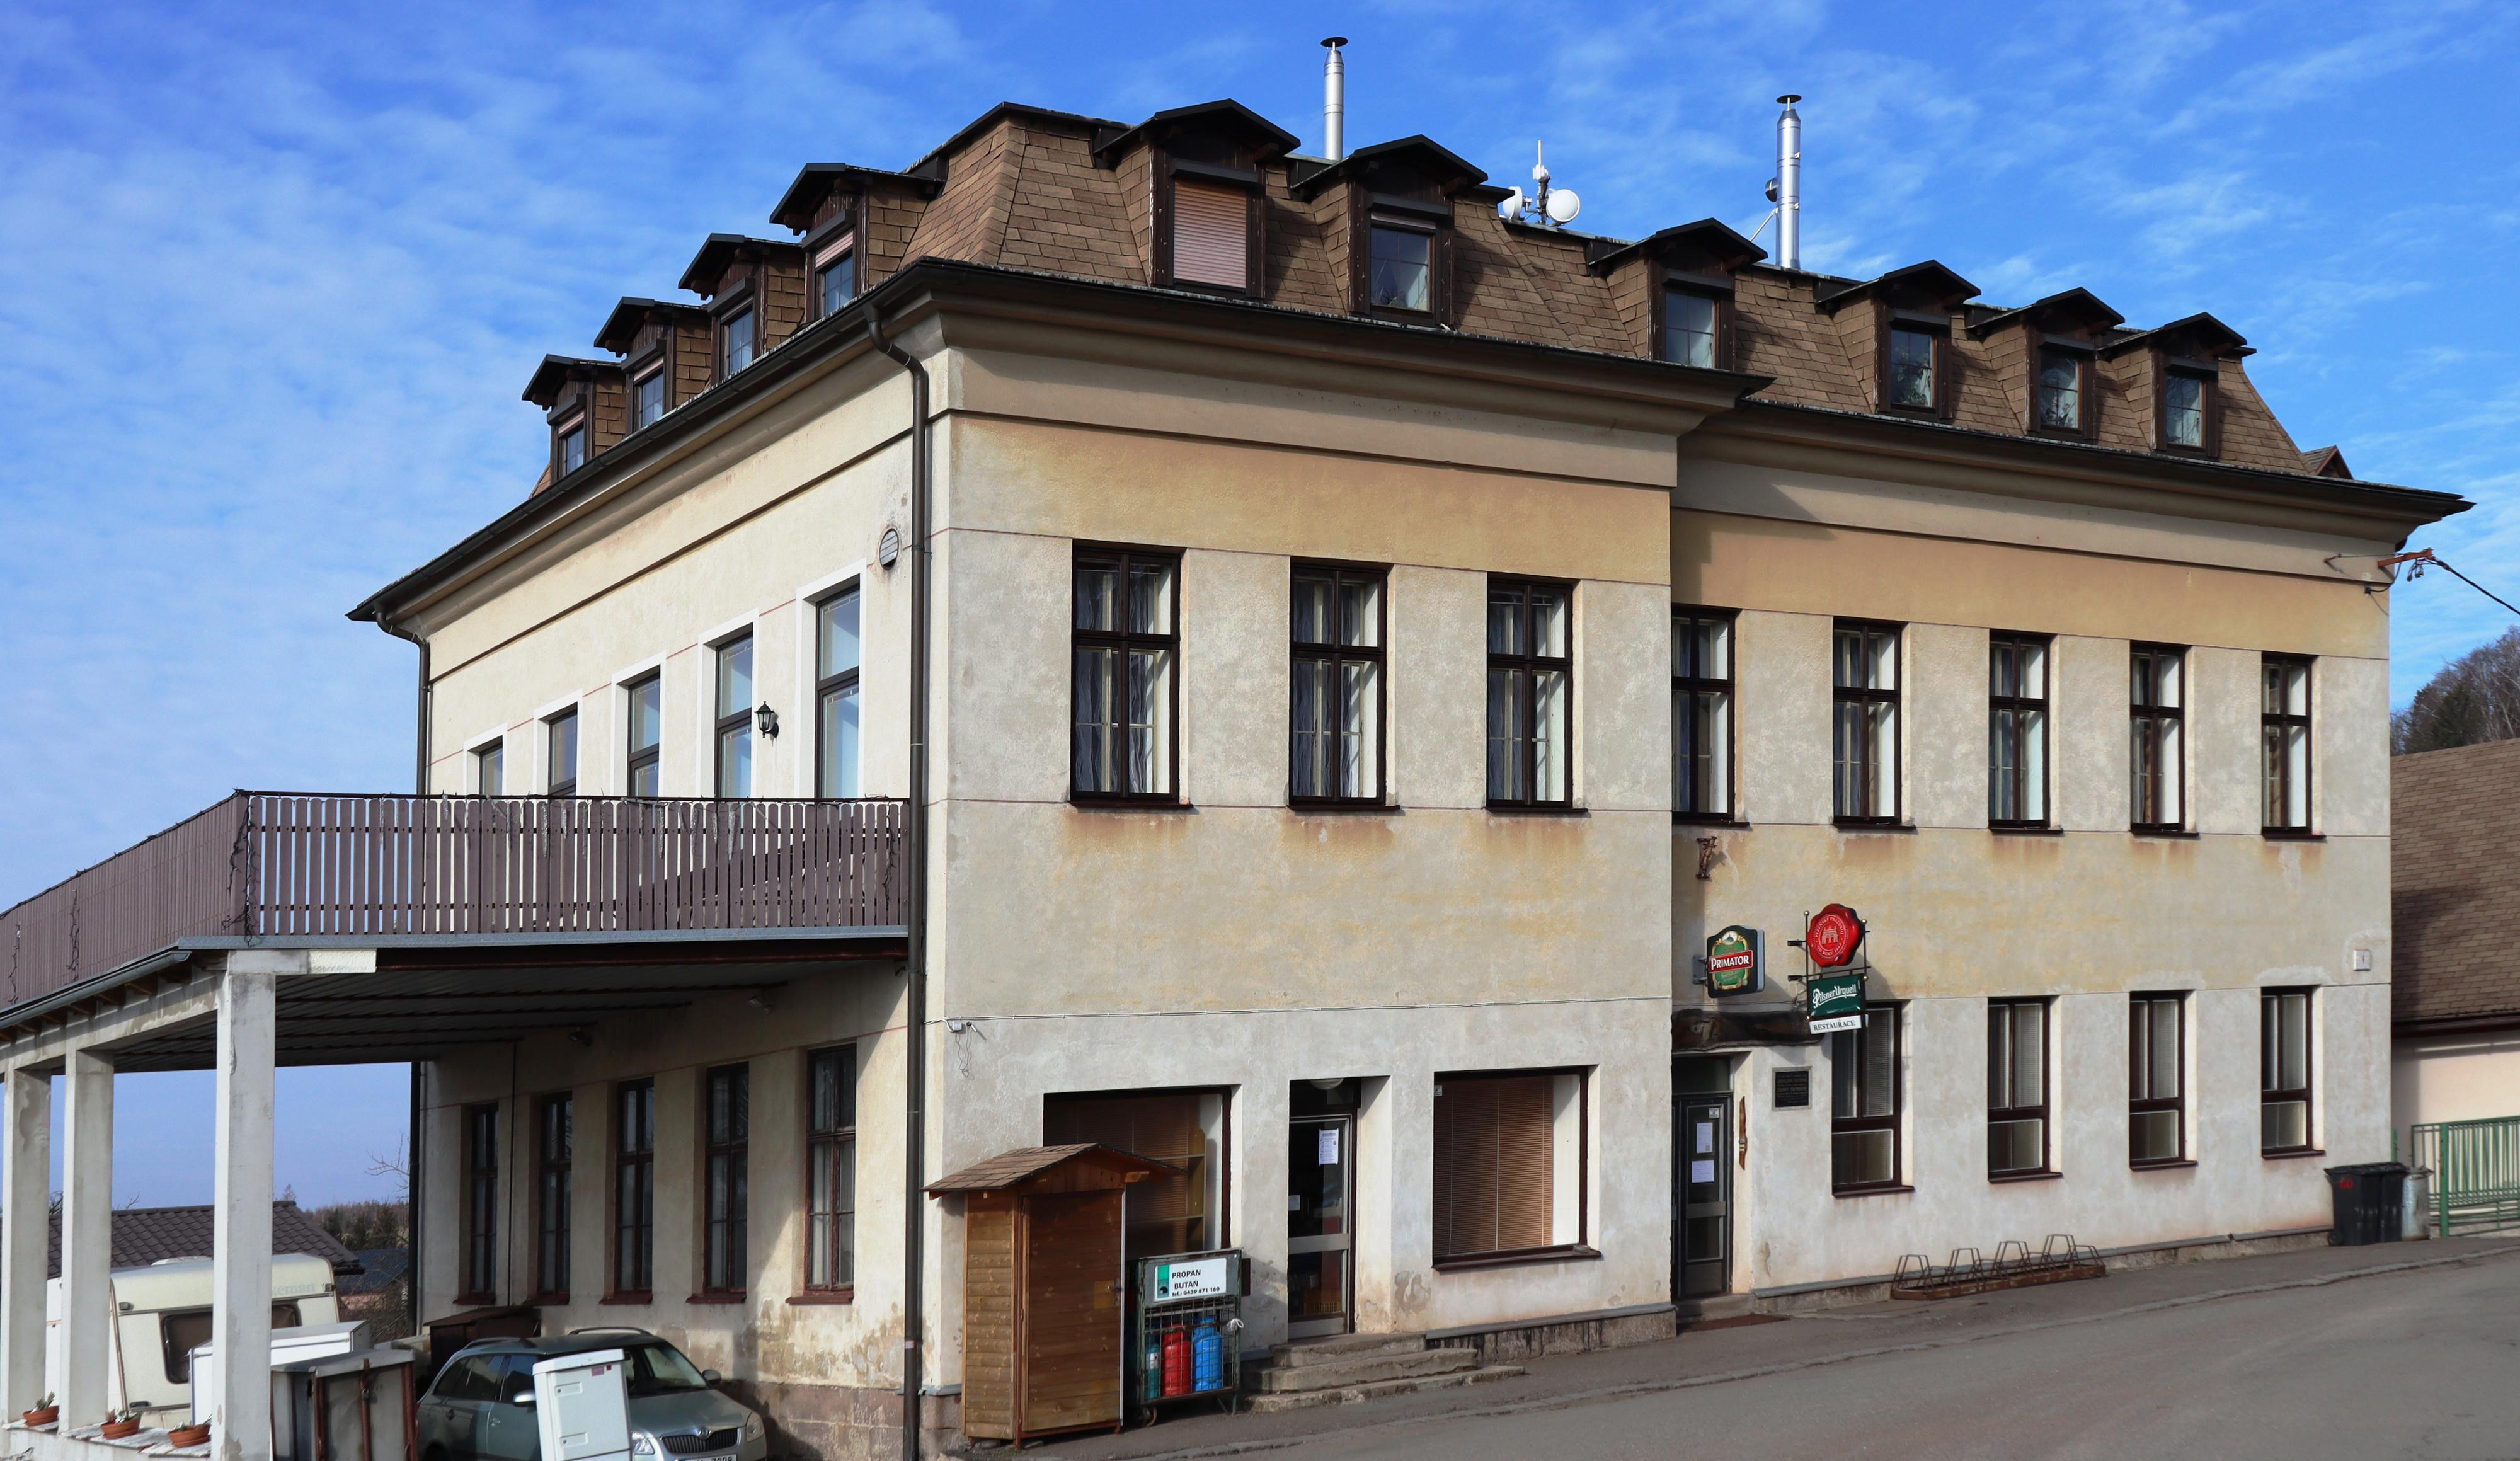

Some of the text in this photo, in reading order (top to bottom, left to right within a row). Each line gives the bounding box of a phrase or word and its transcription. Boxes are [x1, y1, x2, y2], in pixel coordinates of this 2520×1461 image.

[1711, 955, 1750, 971] PRIMATOR
[1813, 984, 1857, 1009] Pilsner Urquell
[1813, 1020, 1855, 1031] RESTAURACE
[1172, 1269, 1201, 1279] PROPAN
[1174, 1280, 1198, 1290] BUTAN
